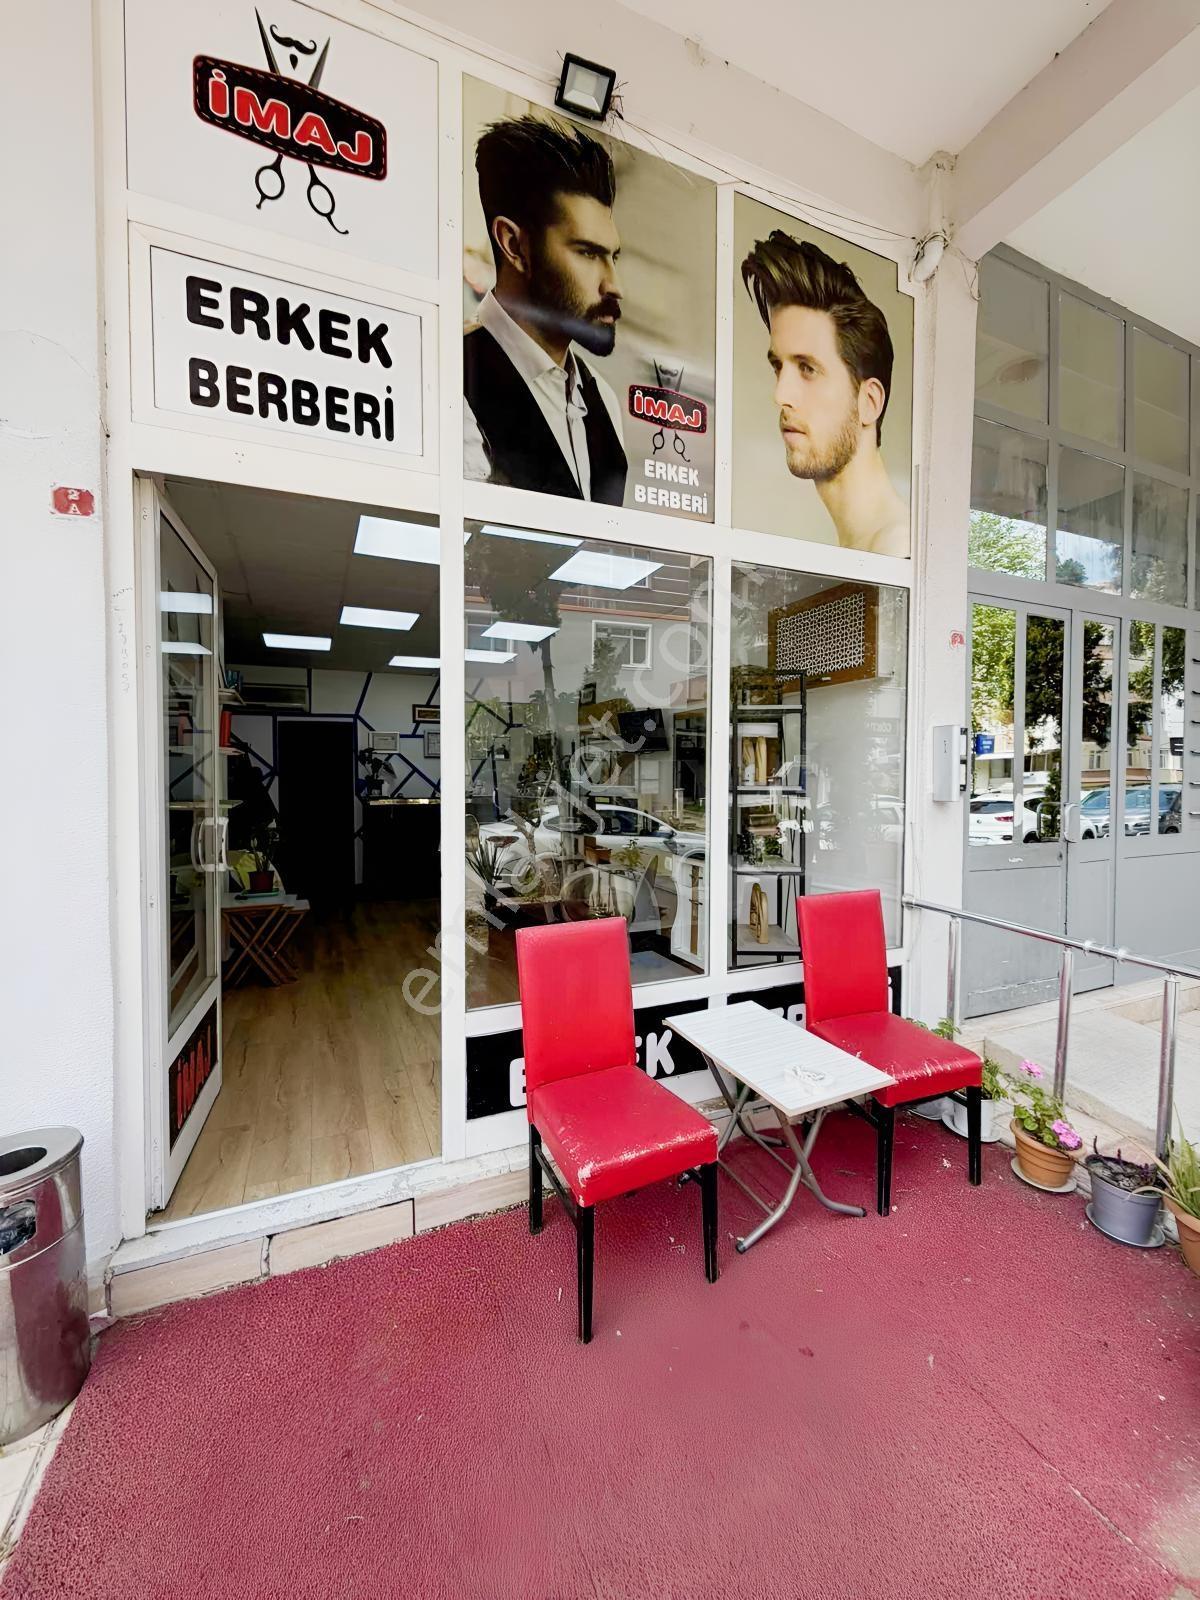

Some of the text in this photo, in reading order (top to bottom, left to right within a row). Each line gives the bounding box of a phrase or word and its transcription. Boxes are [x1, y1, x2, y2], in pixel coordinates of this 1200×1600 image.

[208, 69, 373, 166] İMAJ
[185, 275, 393, 369] ERKEK
[188, 357, 395, 442] BERBERİ
[634, 390, 702, 427] İMAJ
[634, 484, 709, 515] BERBERİ
[644, 458, 700, 487] ERKEK
